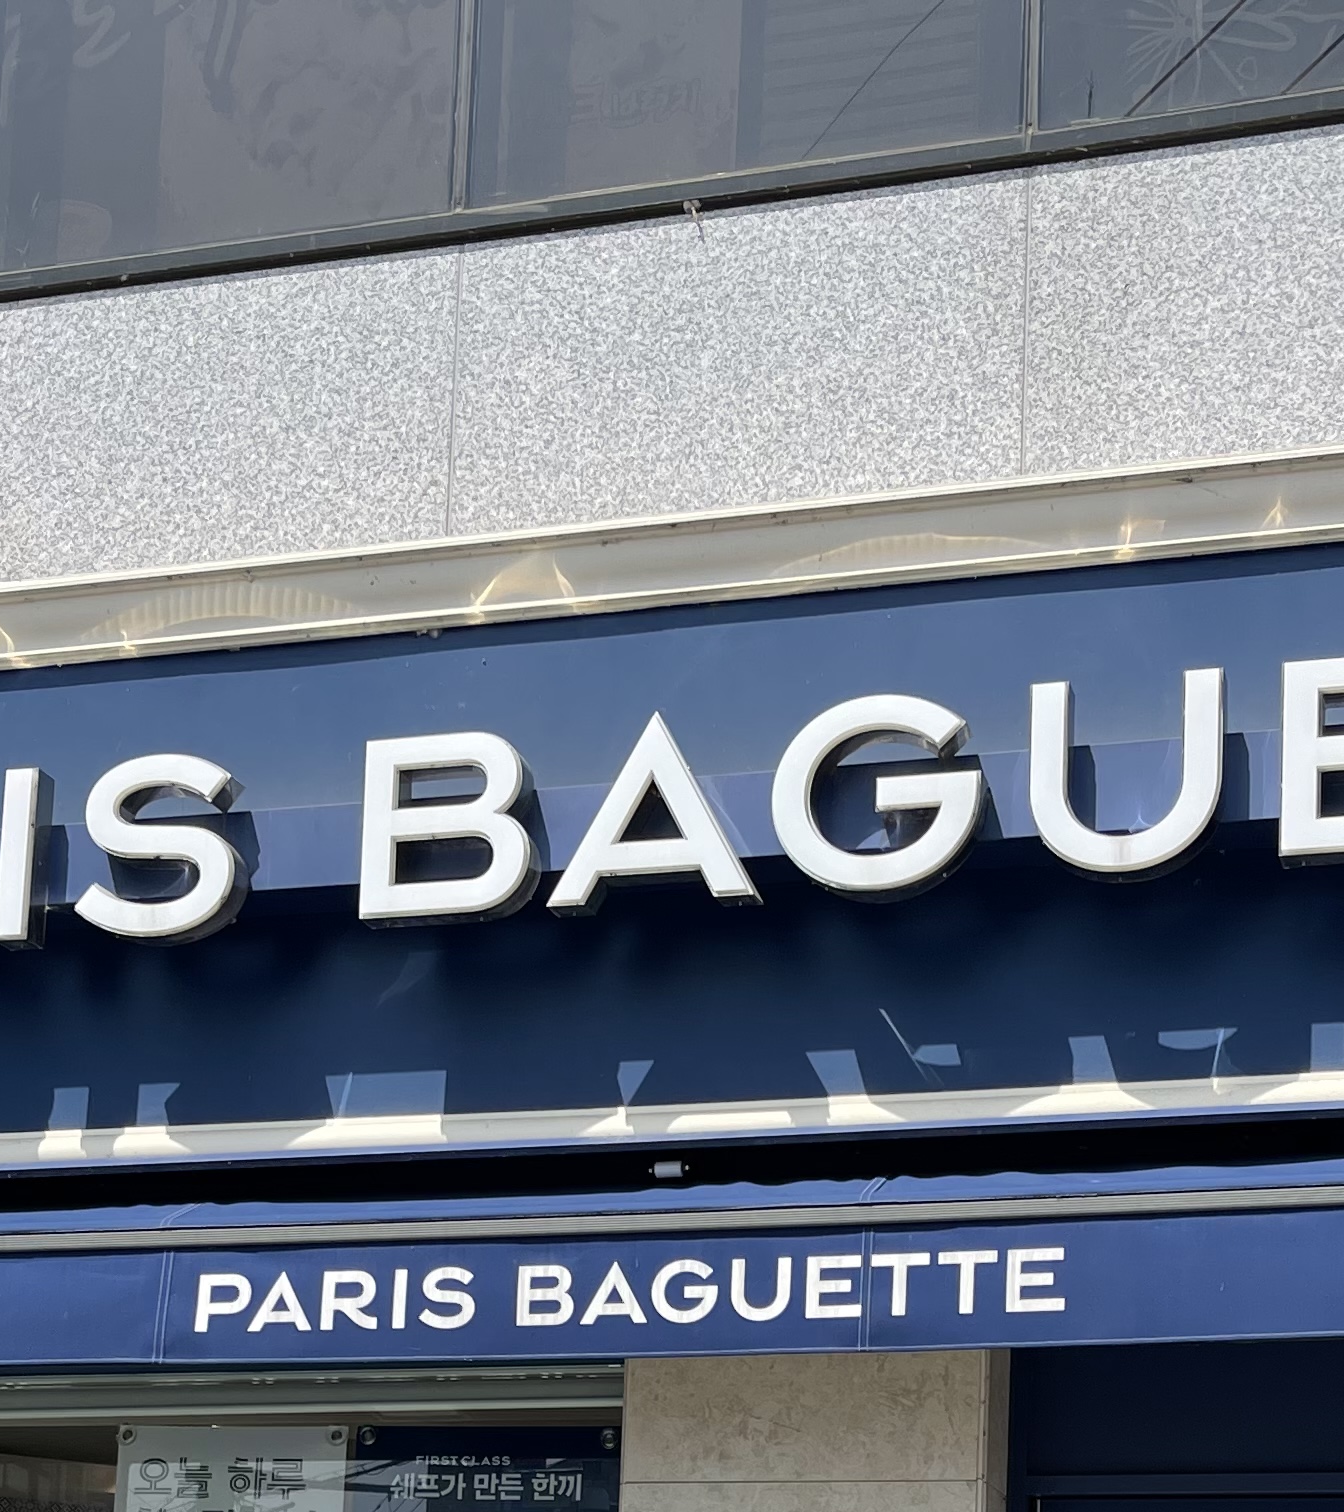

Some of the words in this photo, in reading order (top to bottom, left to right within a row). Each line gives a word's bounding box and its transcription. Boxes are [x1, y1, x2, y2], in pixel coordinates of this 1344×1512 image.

[193, 1266, 476, 1334] PARIS
[515, 1247, 1067, 1325] BAGUETTE
[133, 1457, 213, 1499] 오늘
[227, 1457, 306, 1500] 하루
[415, 1455, 458, 1467] FIRST
[462, 1455, 511, 1467] CLASS
[473, 1473, 524, 1501] 만든
[531, 1472, 583, 1502] 한끼
